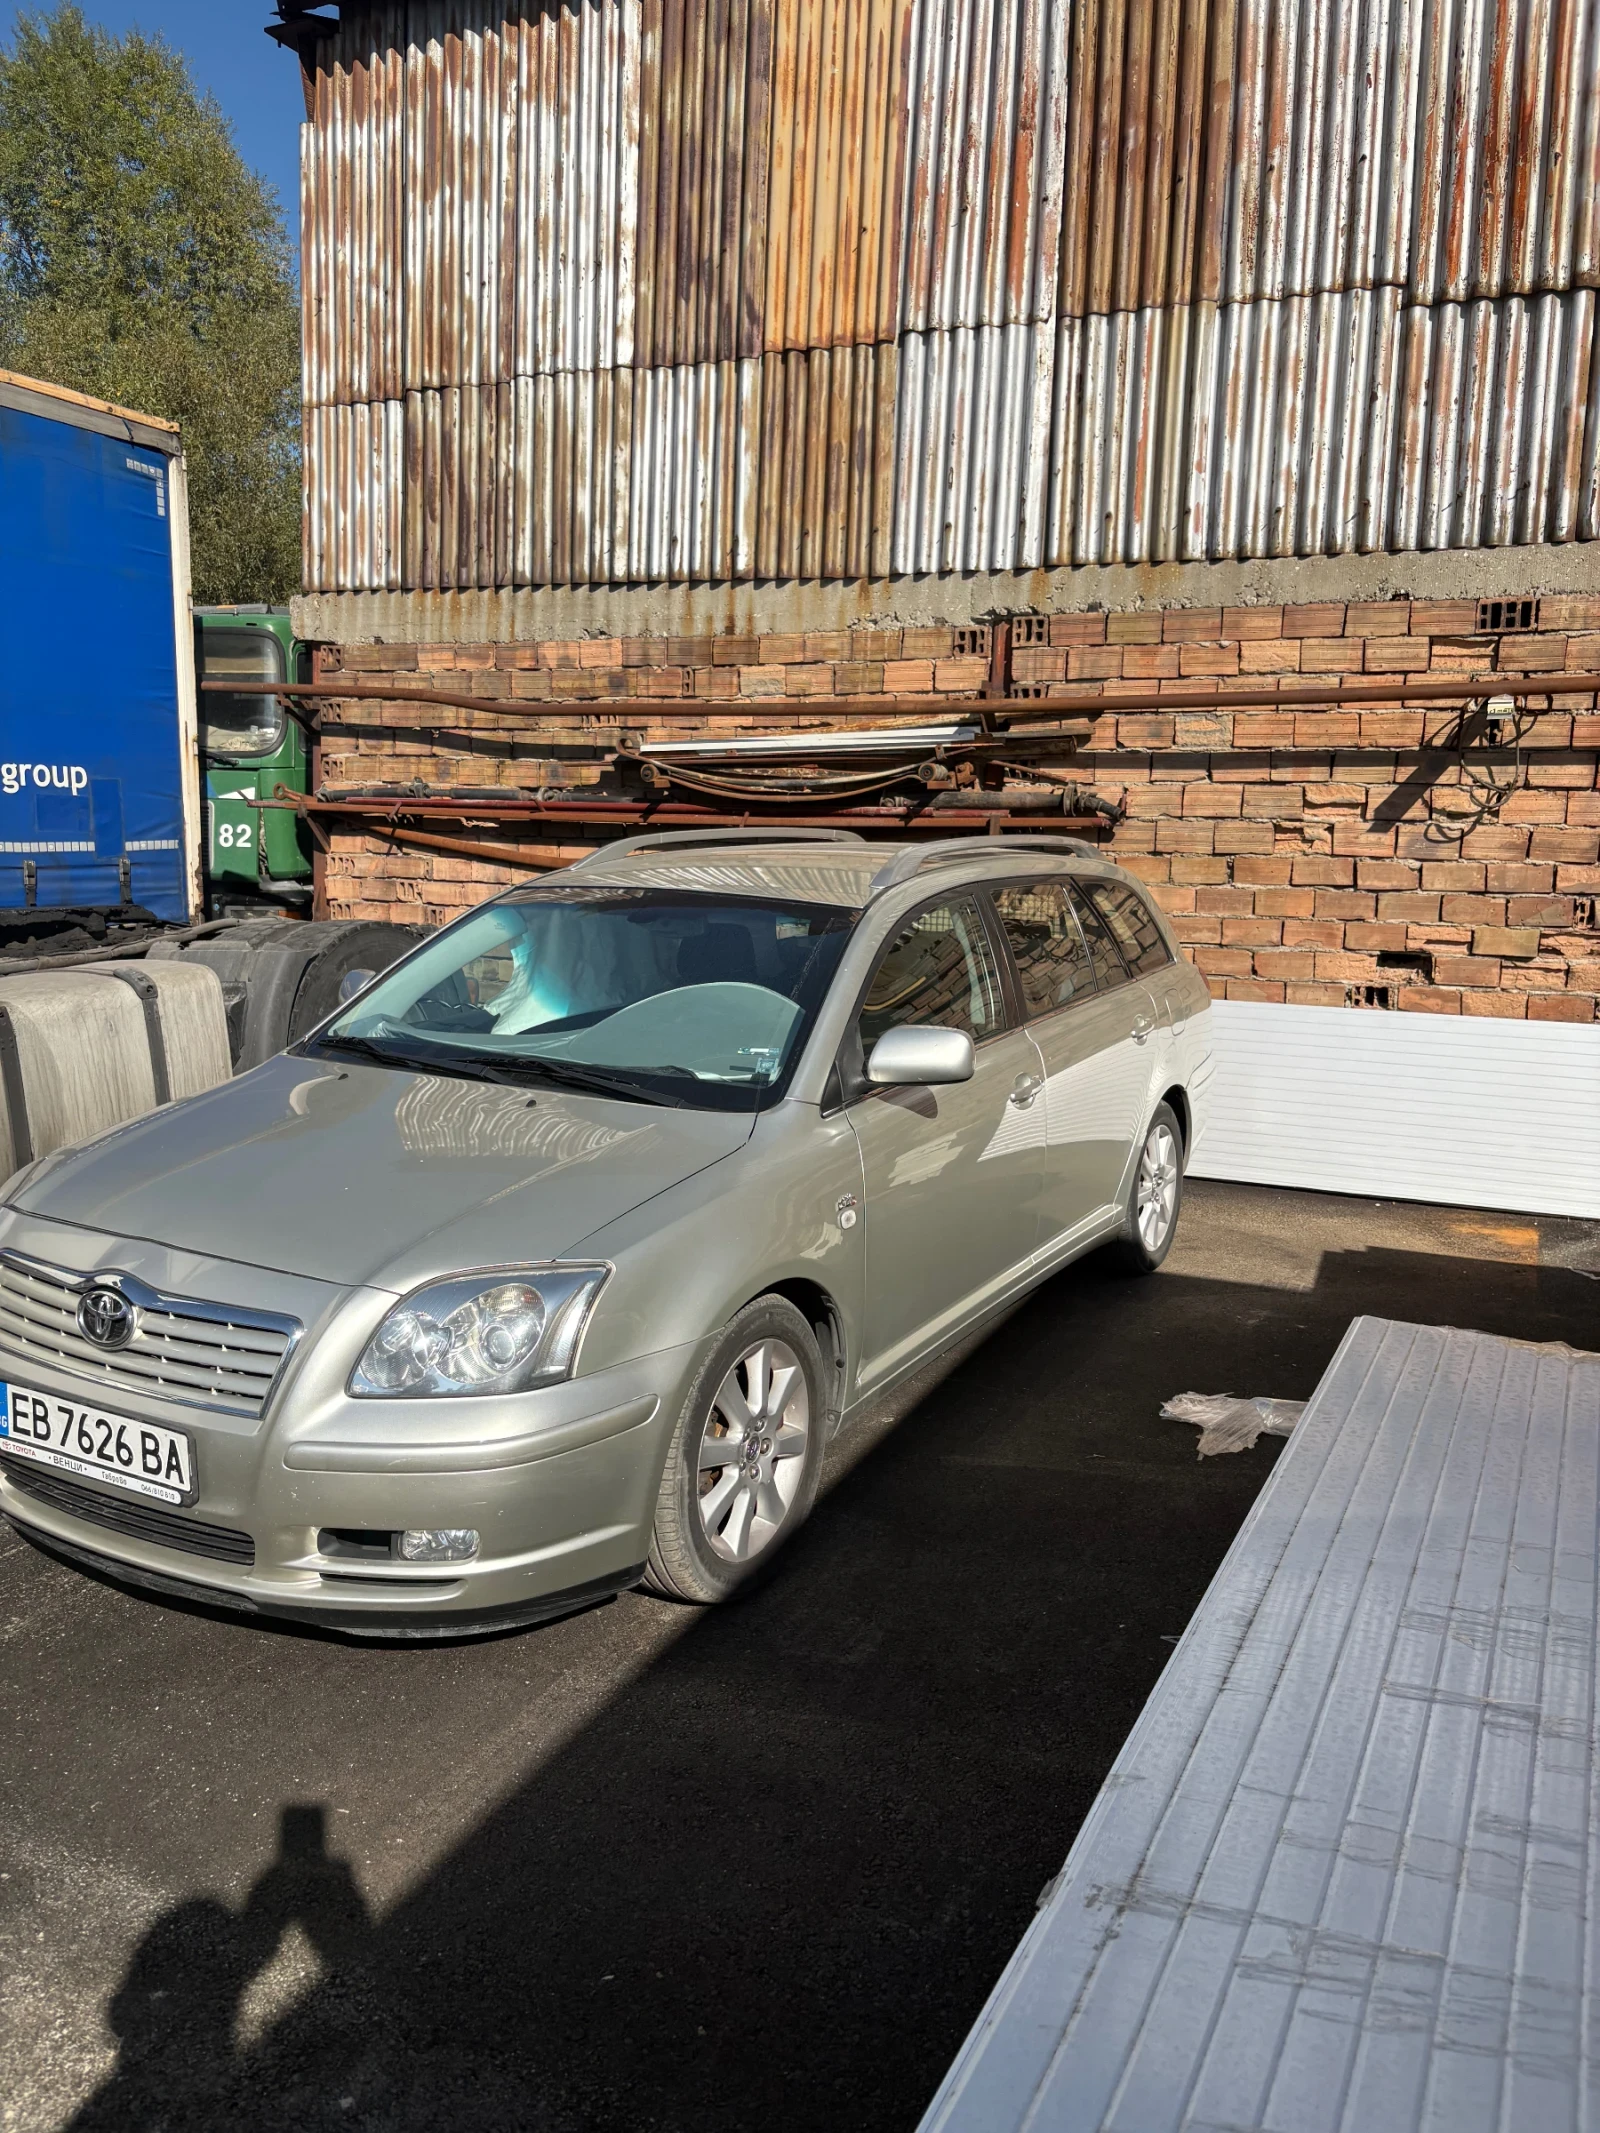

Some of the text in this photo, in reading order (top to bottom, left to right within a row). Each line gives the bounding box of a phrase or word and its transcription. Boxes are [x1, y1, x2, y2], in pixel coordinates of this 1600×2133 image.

[1, 762, 88, 796] group
[218, 823, 252, 848] 82
[0, 1415, 8, 1428] G
[11, 1392, 185, 1485] EB 7626 BA
[12, 1444, 37, 1457] TOYOTA
[53, 1455, 83, 1472] ВЕНЦИ
